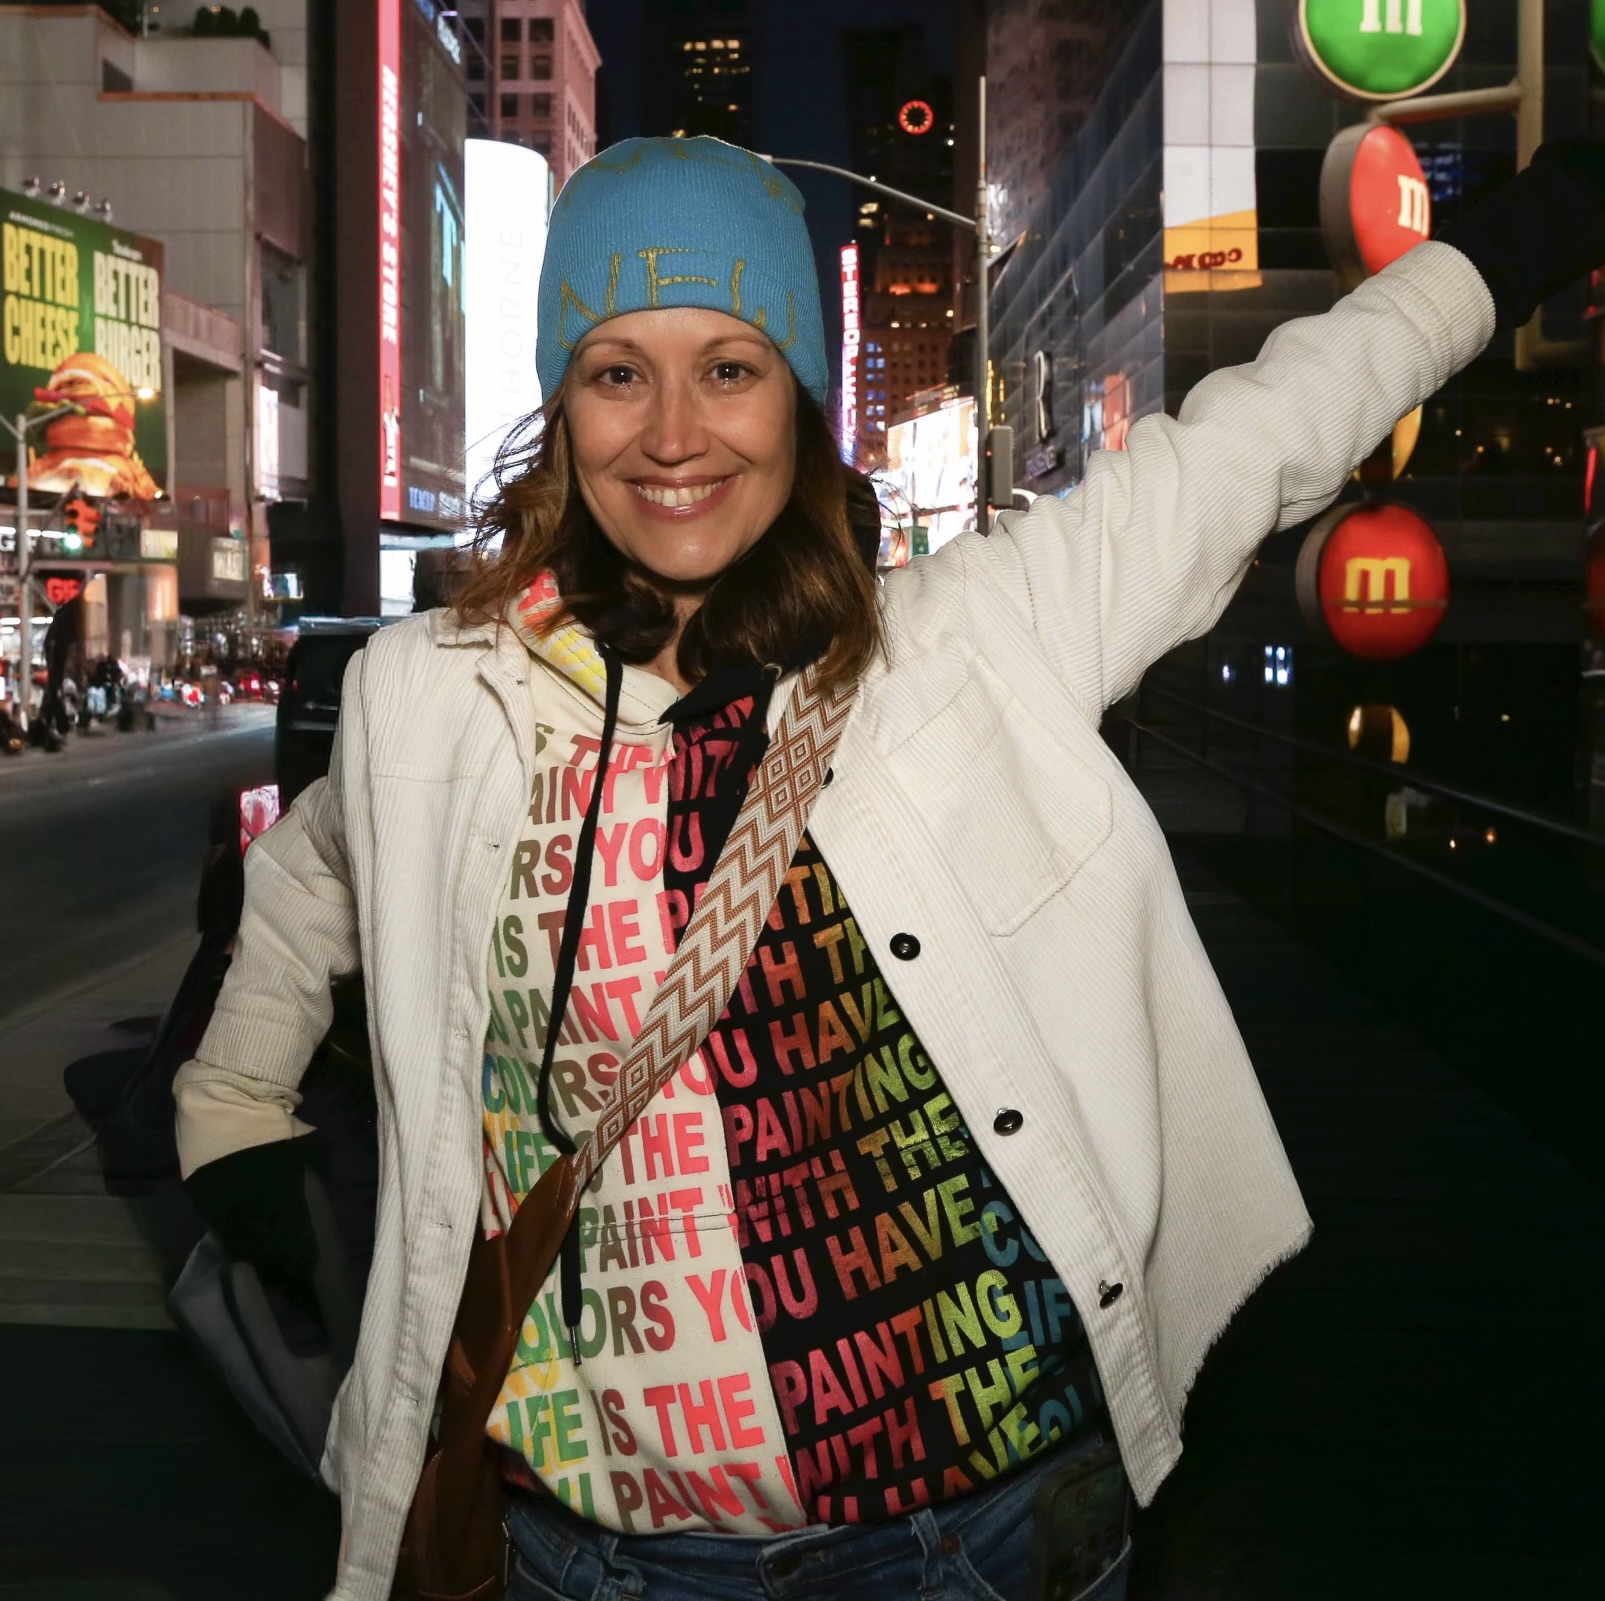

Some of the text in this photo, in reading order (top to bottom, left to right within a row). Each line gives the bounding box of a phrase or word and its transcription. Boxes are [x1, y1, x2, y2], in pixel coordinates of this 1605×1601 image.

[382, 65, 398, 345] HERSHEY'S STORE
[1397, 174, 1430, 235] m
[3, 222, 79, 308] BETTER
[94, 250, 160, 328] BETTER
[4, 294, 79, 371] CHEESE
[94, 316, 162, 390] BURGER
[1345, 557, 1411, 614] m
[527, 766, 618, 826] AINT
[596, 812, 704, 887] YOU
[492, 914, 528, 978] IS
[537, 899, 647, 972] THE
[769, 977, 899, 1076] HAVE
[620, 1112, 710, 1186] THE
[721, 1033, 937, 1167] PAINTING
[579, 1187, 704, 1273] PAINT
[718, 1149, 860, 1249] WITH
[856, 1092, 971, 1193] THE
[515, 1280, 676, 1363] OLORS
[685, 1248, 819, 1343] YOU
[826, 1173, 998, 1300] HAVE
[506, 1389, 589, 1467] IFE
[590, 1388, 638, 1457] IS
[643, 1372, 765, 1458] THE
[770, 1269, 1023, 1436] PAINTING
[609, 1462, 768, 1533] PAINT
[775, 1397, 927, 1511] WITH
[928, 1344, 1040, 1446] THE
